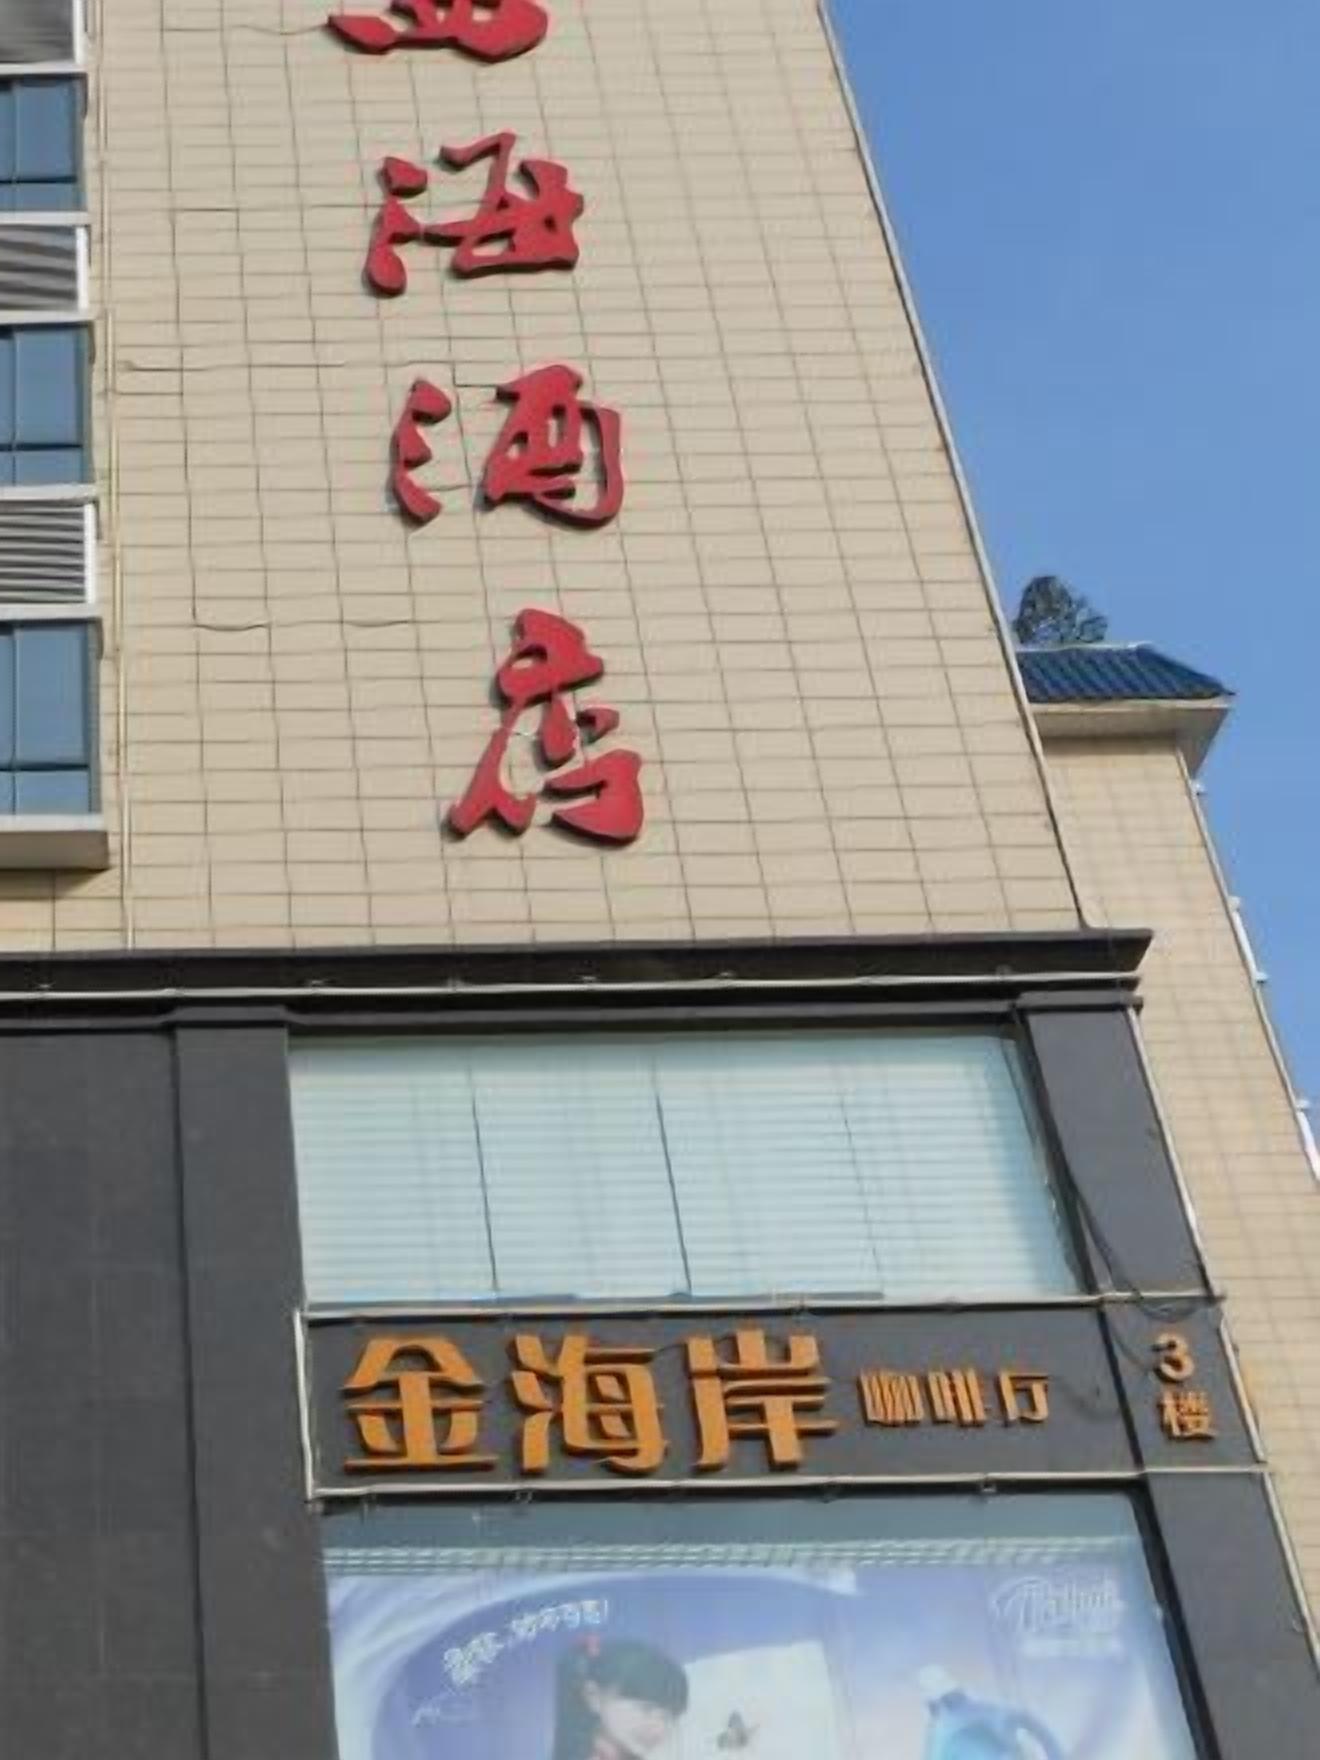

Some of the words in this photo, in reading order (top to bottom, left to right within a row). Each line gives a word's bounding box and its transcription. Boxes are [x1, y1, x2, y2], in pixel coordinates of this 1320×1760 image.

[343, 1329, 840, 1476] 金海岸
[858, 1368, 1049, 1427] 咖啡厅
